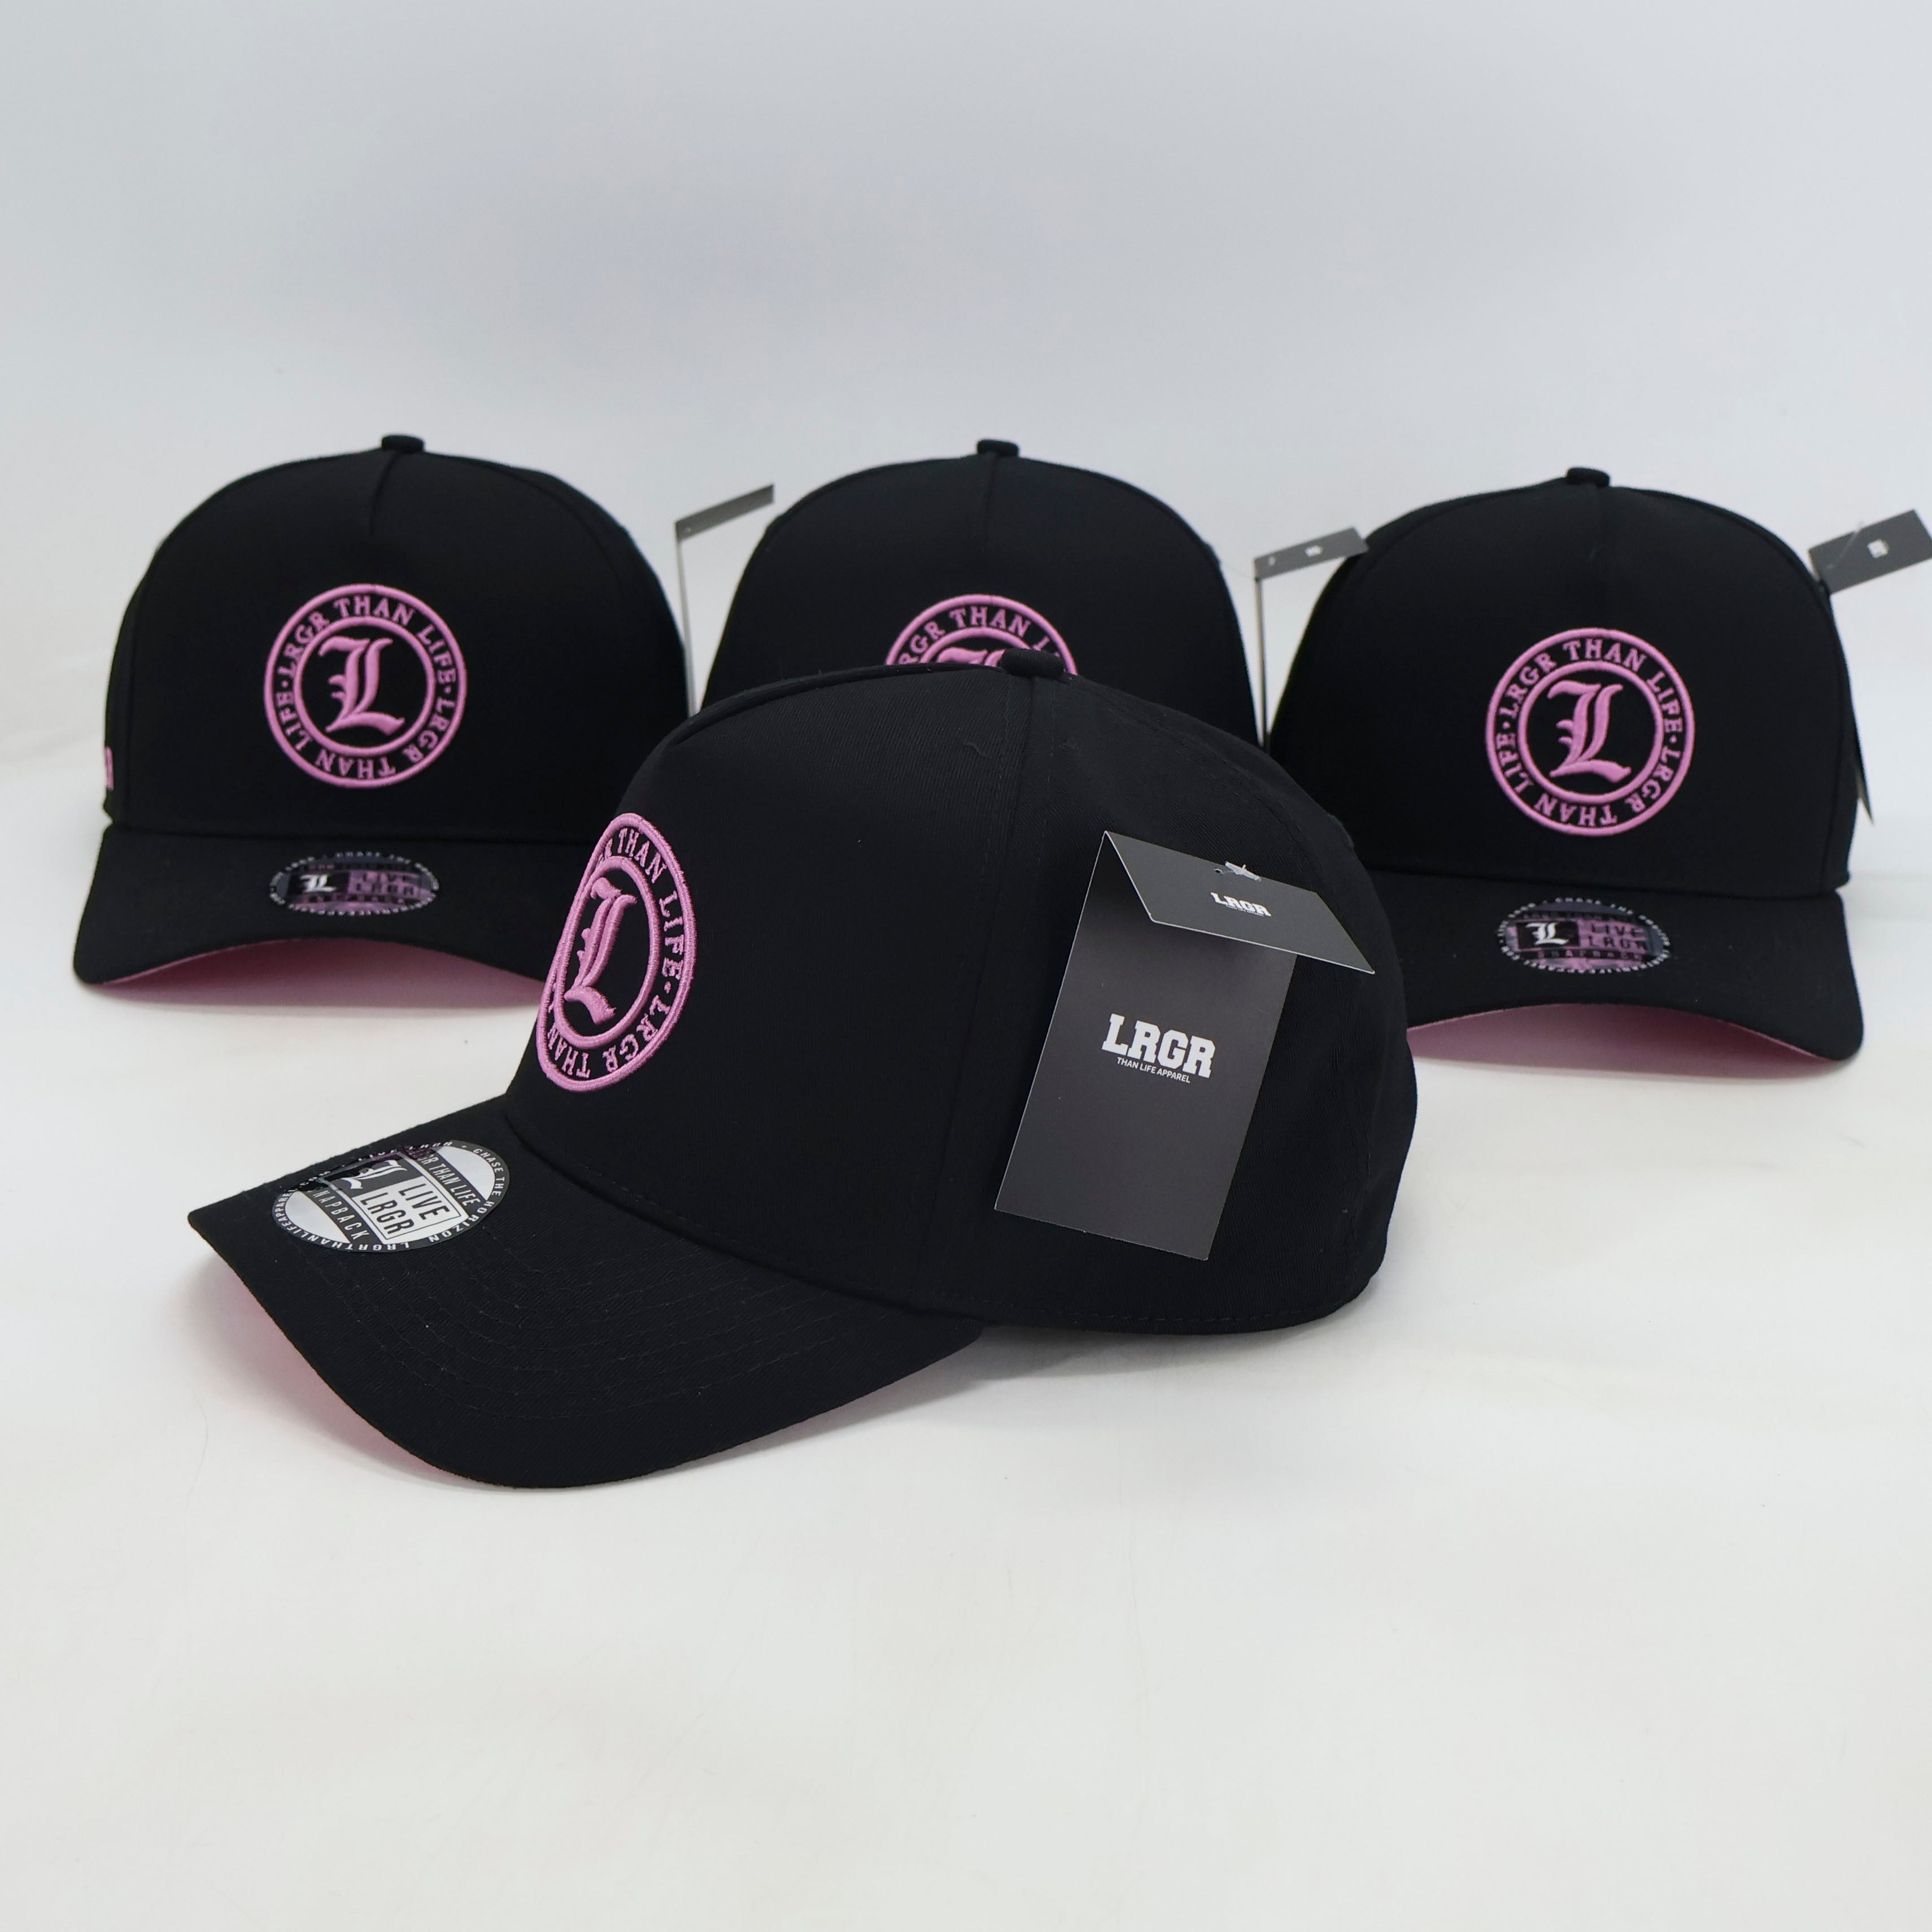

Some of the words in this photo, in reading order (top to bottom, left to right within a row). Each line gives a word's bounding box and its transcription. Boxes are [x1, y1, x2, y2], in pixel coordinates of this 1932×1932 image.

[278, 611, 330, 679] LRGR
[333, 595, 416, 627] THAN
[417, 624, 456, 684] LIFE
[898, 620, 945, 665] RGR
[948, 606, 1031, 638] THAN
[318, 635, 406, 735] L
[1498, 652, 1558, 719] LRGR
[1562, 638, 1647, 671] THAN
[1646, 670, 1683, 733] LIFE
[275, 691, 314, 751] LIFE
[403, 697, 455, 764] LRGR
[1546, 679, 1632, 783] L
[314, 751, 397, 779] THAN
[1495, 732, 1534, 795] LIFE
[1624, 745, 1681, 813] LRGR
[1534, 792, 1617, 826] THAN
[617, 827, 667, 884] THAN
[658, 890, 685, 980] LIFE
[1210, 892, 1272, 917] LRGR
[565, 877, 638, 1026] L
[602, 995, 671, 1072] LRGR
[1101, 1013, 1216, 1078] LRGR
[1117, 1057, 1139, 1070] THAN
[1140, 1063, 1157, 1074] LIFE
[1157, 1068, 1191, 1084] APPAREL
[429, 1163, 461, 1185] THAN
[450, 1184, 481, 1206] LIFE
[473, 1148, 504, 1173] CHASE
[491, 1176, 505, 1197] THE
[307, 1188, 370, 1240] NAPBACK
[360, 1192, 415, 1235] LRGR
[398, 1183, 450, 1220] LIVE
[428, 1201, 495, 1242] HORIZON
